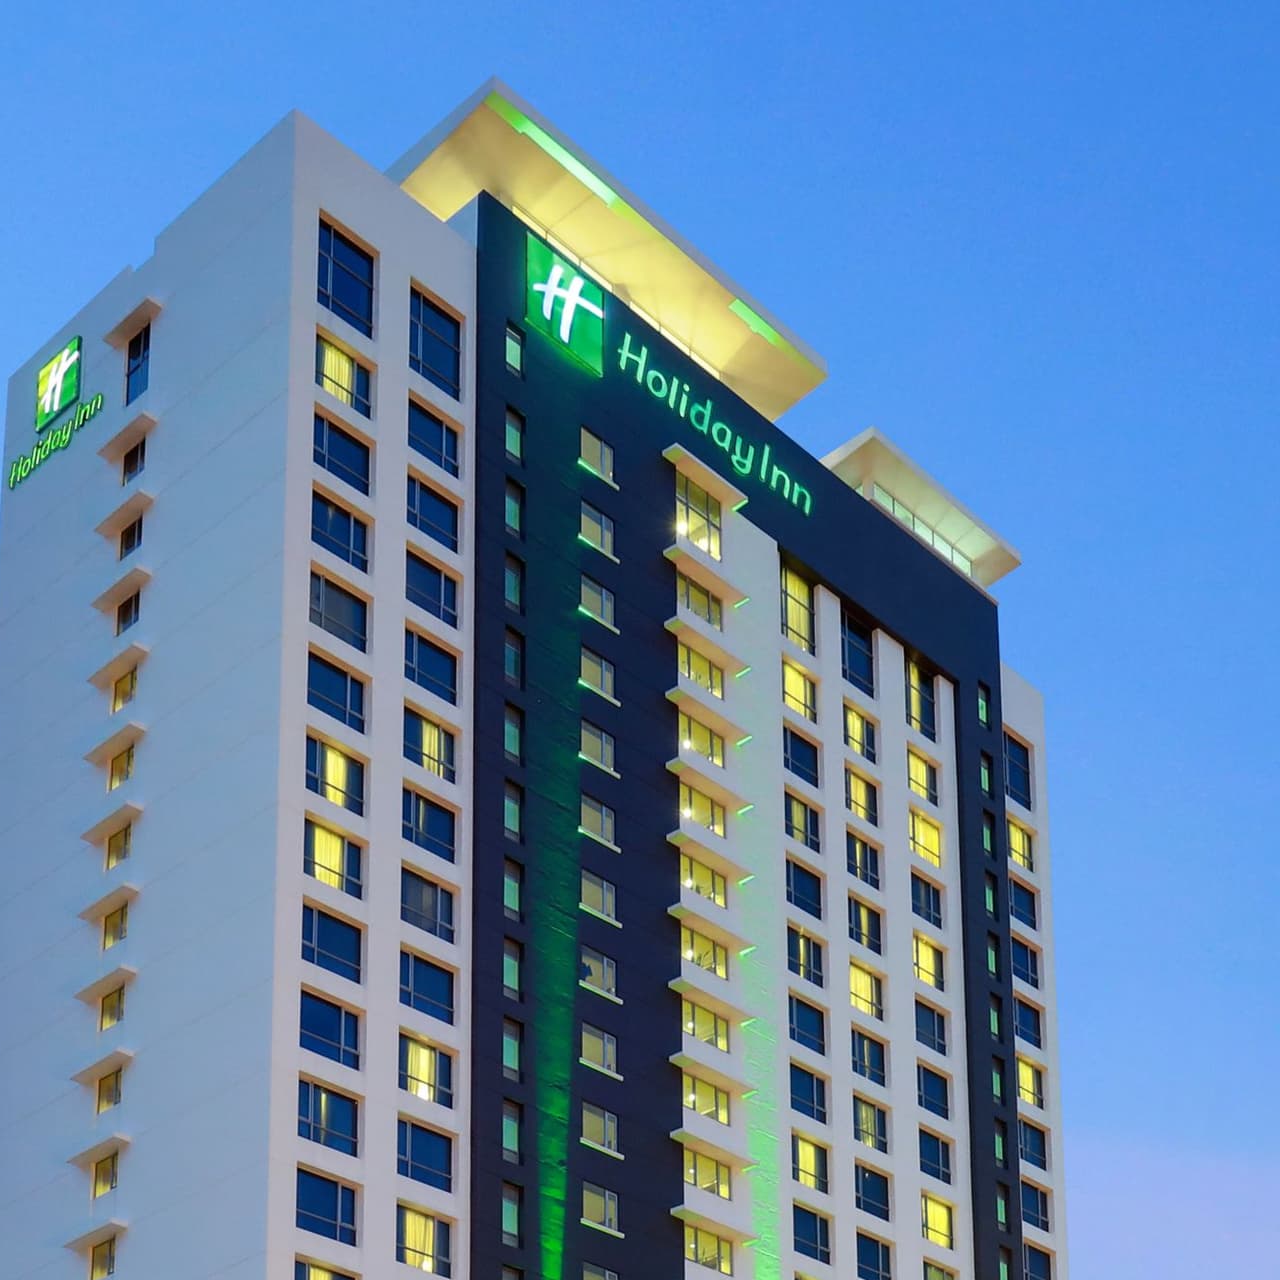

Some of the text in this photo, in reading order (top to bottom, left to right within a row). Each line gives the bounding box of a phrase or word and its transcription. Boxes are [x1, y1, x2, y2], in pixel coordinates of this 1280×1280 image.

[8, 394, 104, 489] Holiday Inn
[617, 331, 812, 517] Holiday Inn
